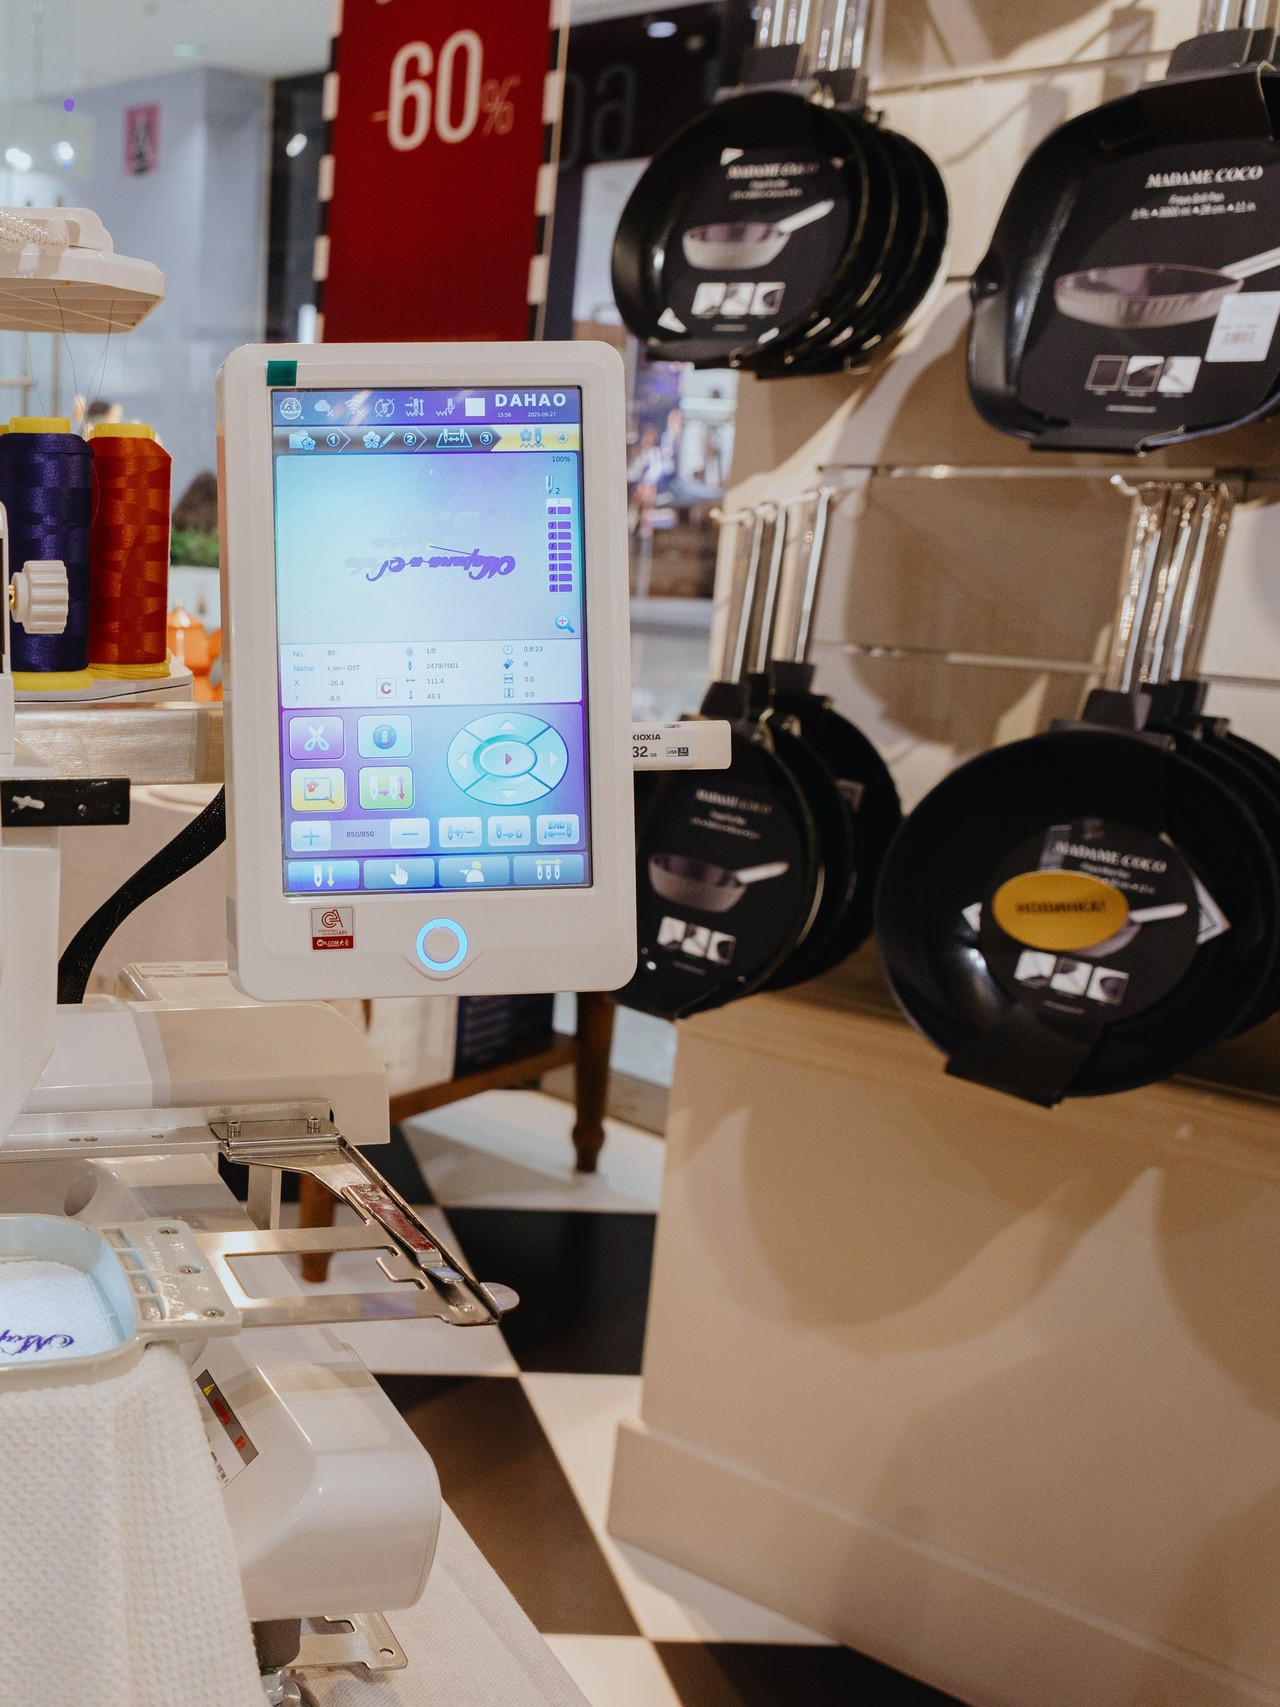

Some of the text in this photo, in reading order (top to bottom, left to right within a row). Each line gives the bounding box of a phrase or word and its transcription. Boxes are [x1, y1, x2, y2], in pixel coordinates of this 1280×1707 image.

[1144, 165, 1263, 188] MADAME COCO
[495, 392, 567, 407] DAHAO
[380, 682, 392, 694] C
[633, 746, 648, 757] 32
[346, 830, 375, 838] 850/850
[1121, 854, 1167, 874] COCO
